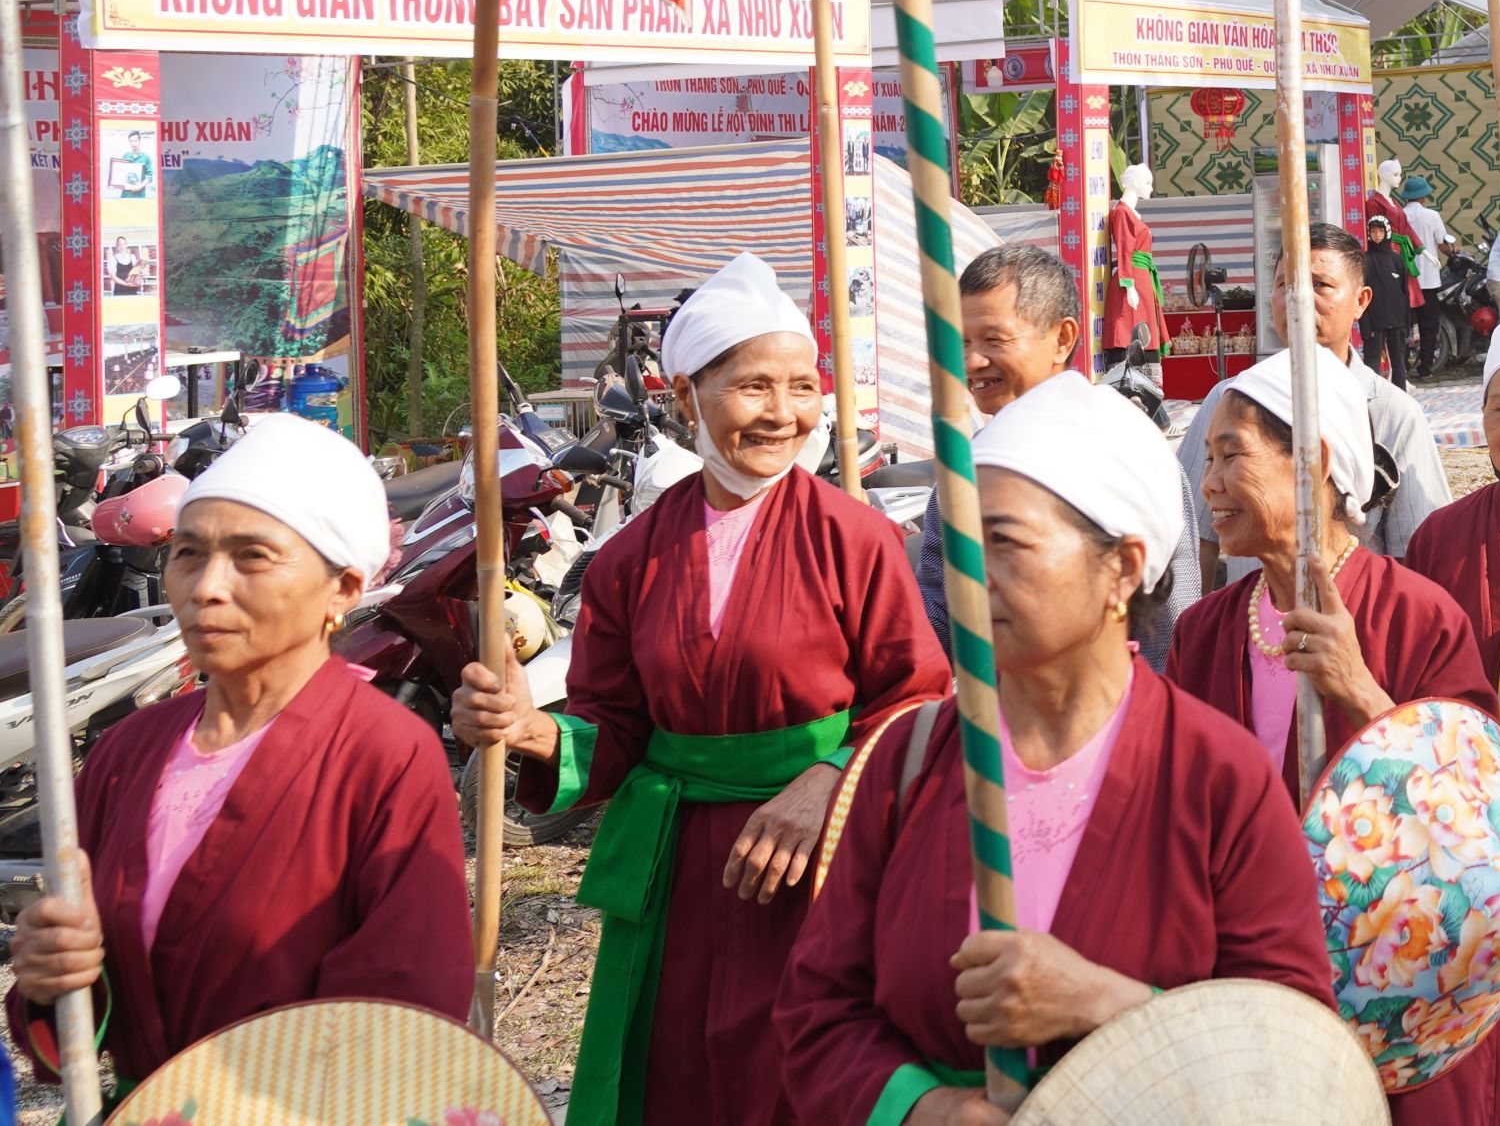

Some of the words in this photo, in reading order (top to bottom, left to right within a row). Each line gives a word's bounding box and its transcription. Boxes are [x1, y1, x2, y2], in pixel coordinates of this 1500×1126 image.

[1136, 14, 1183, 42] KHÔNG
[1188, 22, 1219, 45] GIAN
[1223, 20, 1248, 47] VĂN
[161, 120, 189, 142] HƯ
[195, 117, 251, 142] XUÂN
[632, 107, 668, 132] CHÀO
[672, 108, 708, 132] MỪNG
[711, 105, 723, 132] LỄ
[726, 110, 745, 136] HỘI
[748, 110, 775, 132] ĐÌNH
[778, 114, 796, 132] THI
[873, 111, 897, 132] NĂM
